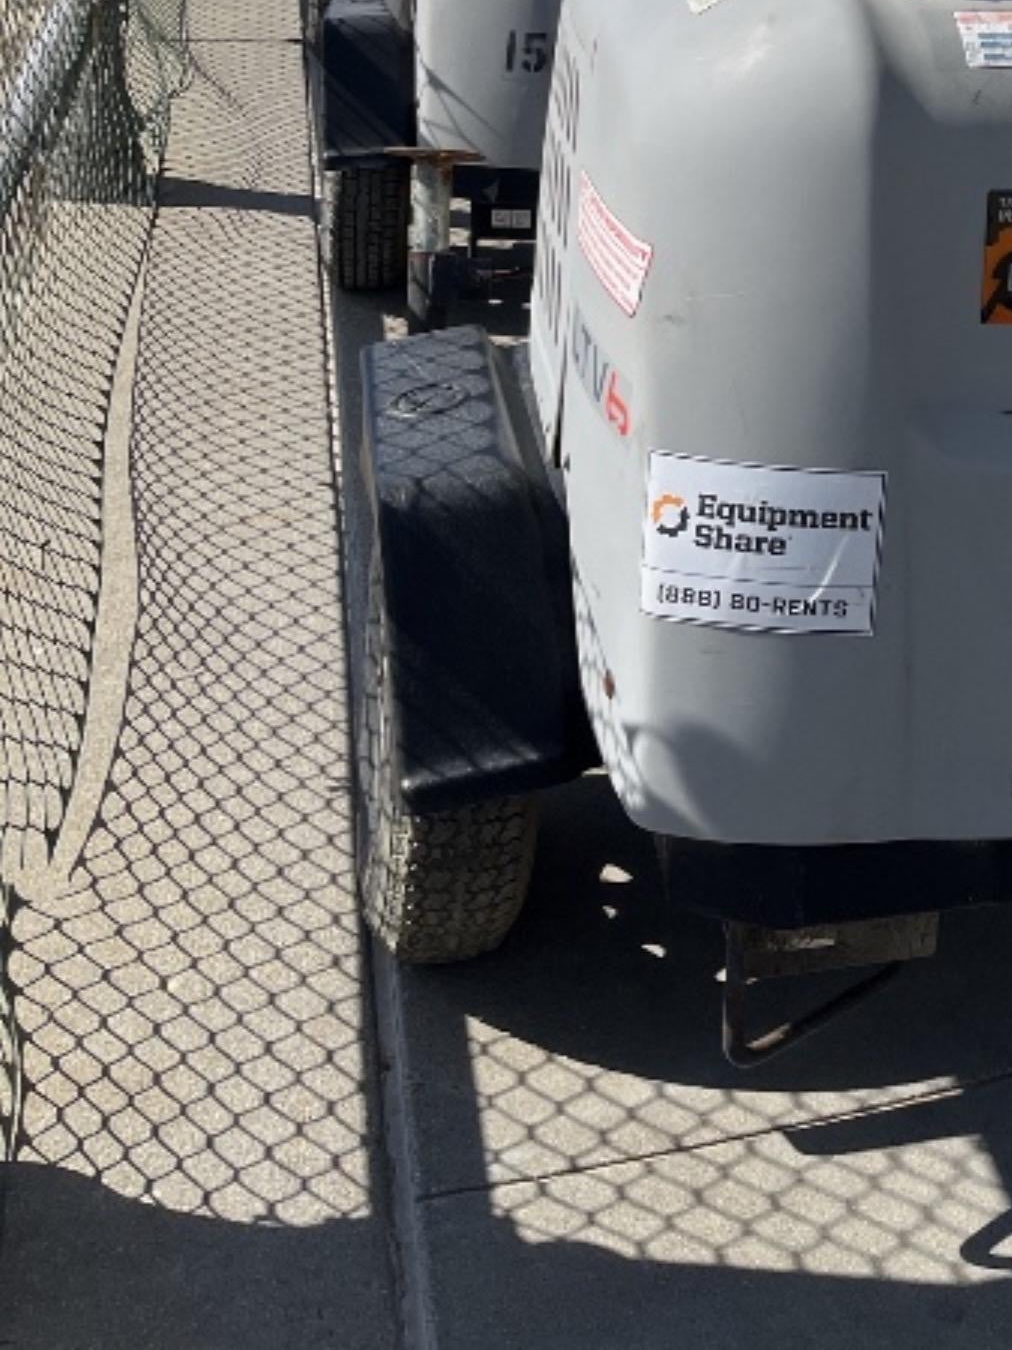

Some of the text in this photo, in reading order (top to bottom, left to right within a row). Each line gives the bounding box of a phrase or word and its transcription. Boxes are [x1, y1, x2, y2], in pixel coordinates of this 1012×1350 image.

[506, 29, 556, 73] 15
[698, 494, 873, 531] Equipment
[694, 525, 788, 556] Share
